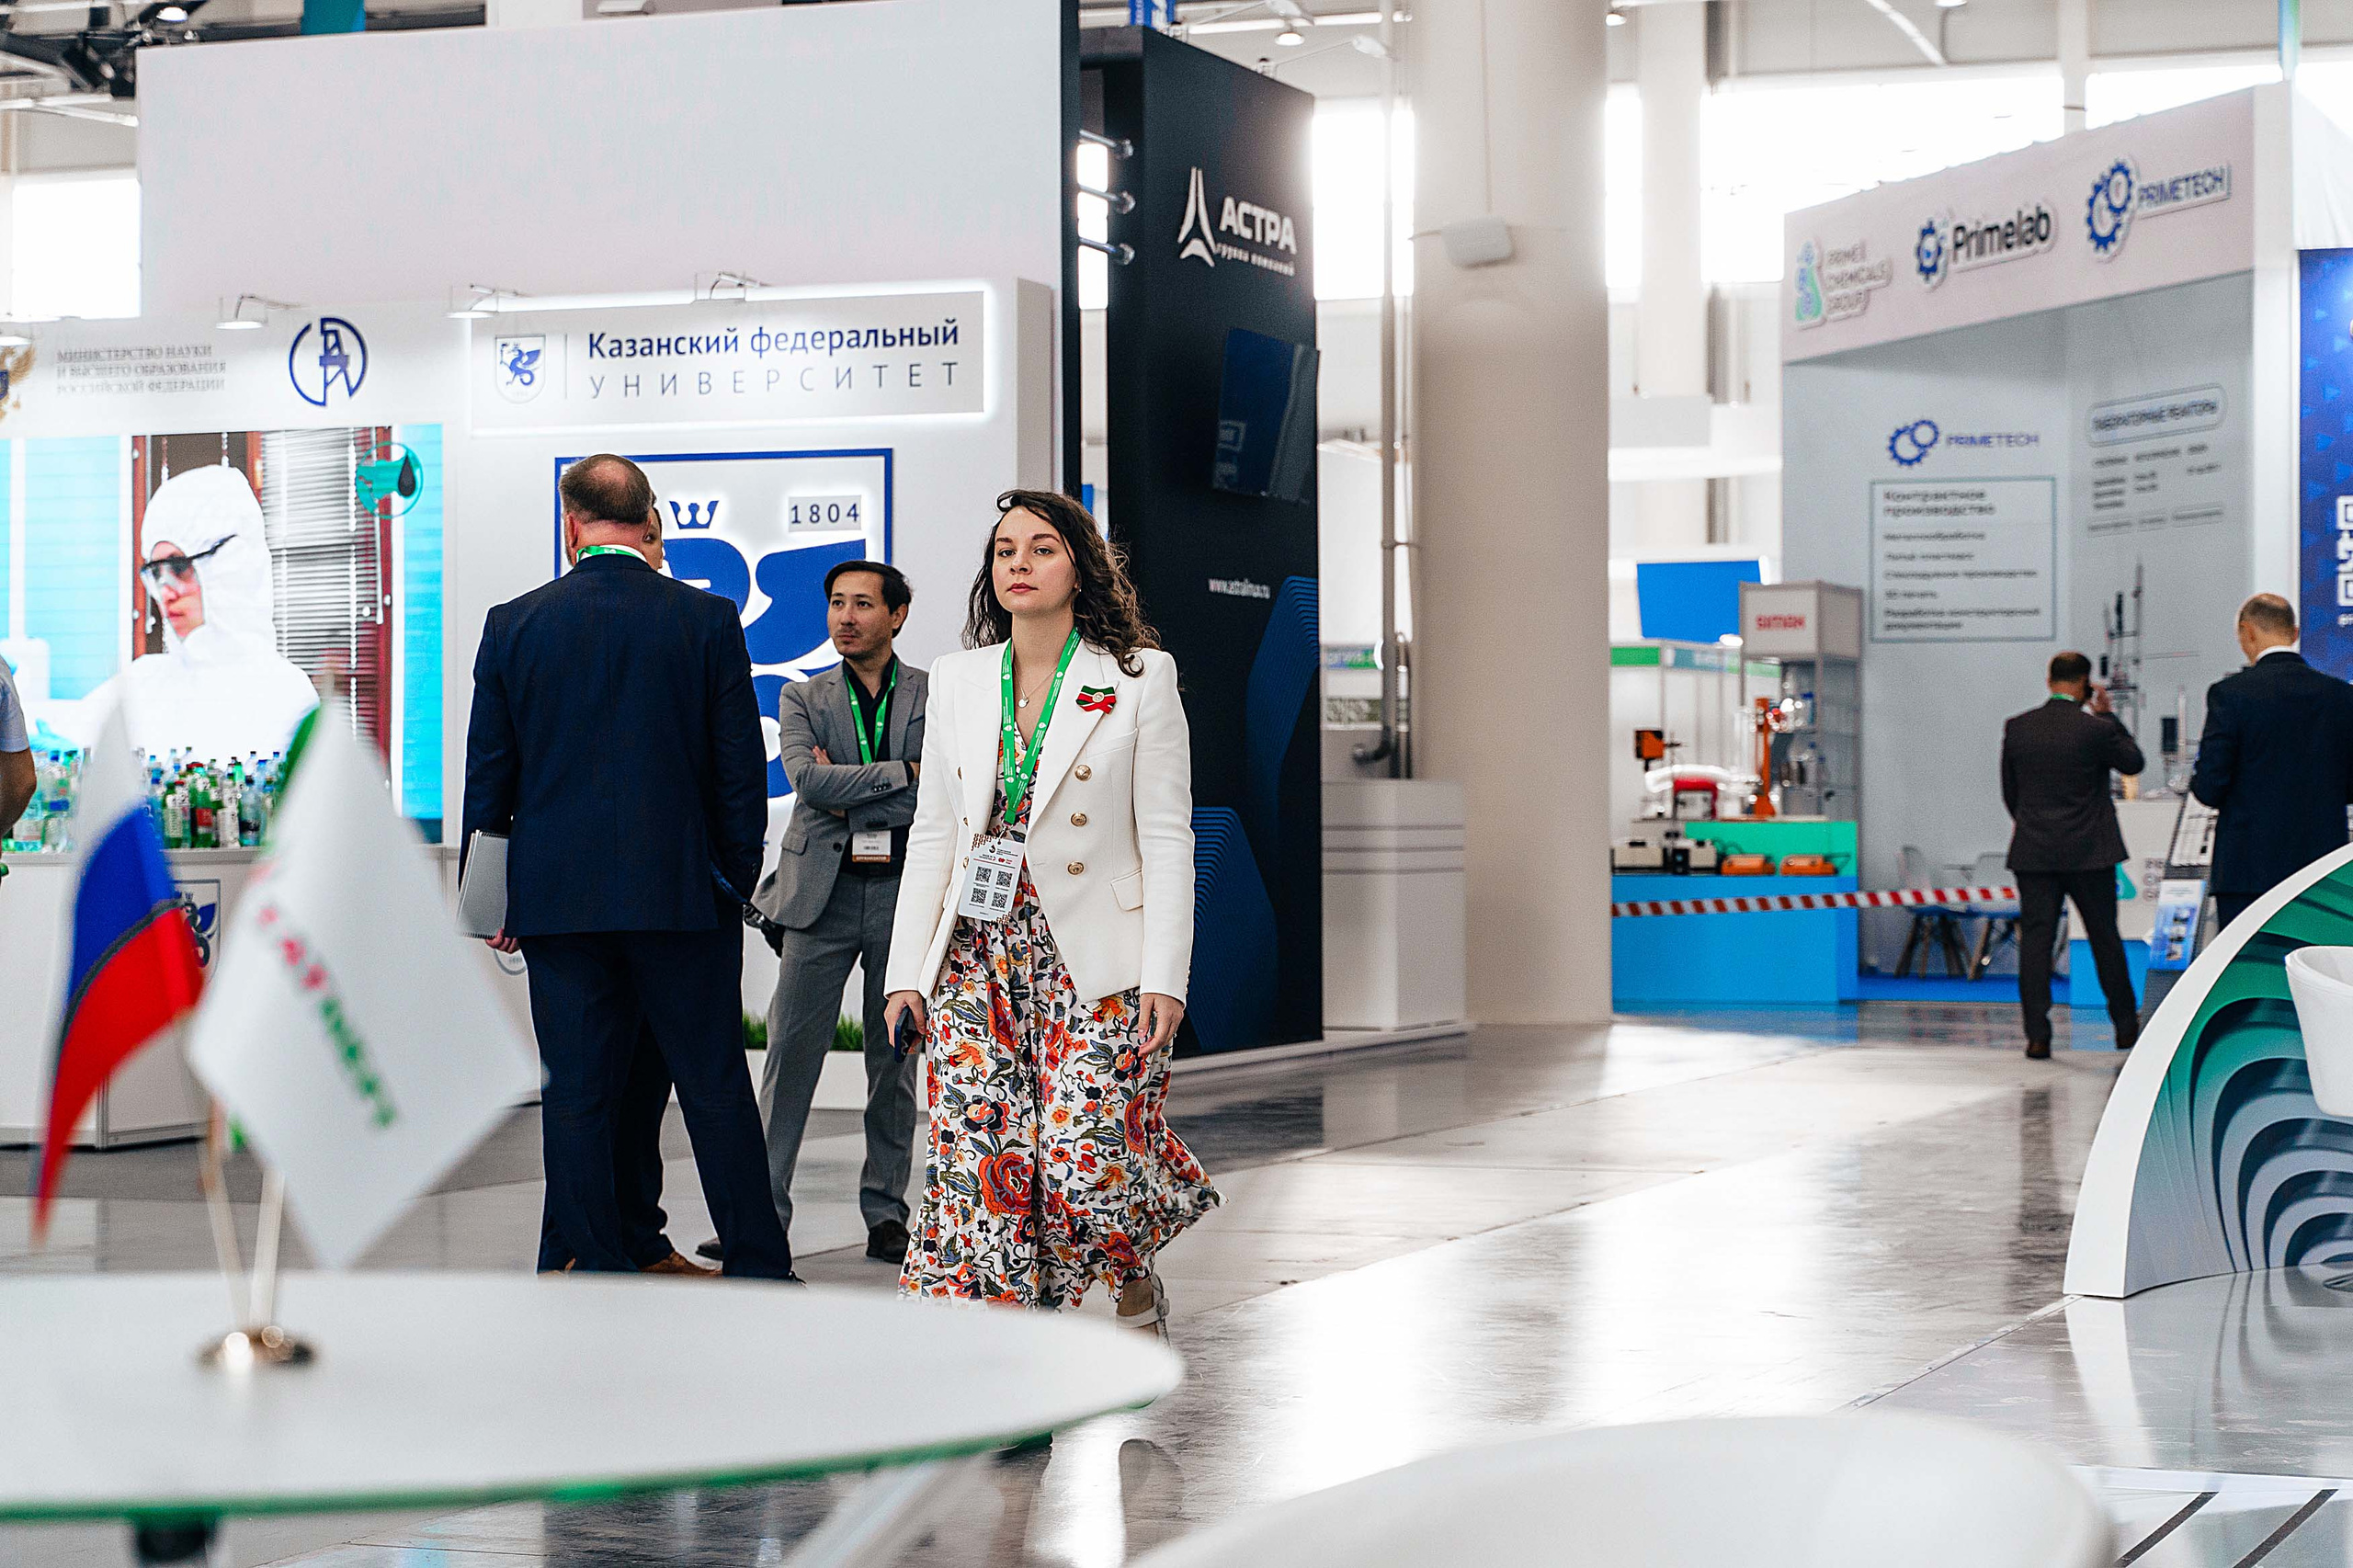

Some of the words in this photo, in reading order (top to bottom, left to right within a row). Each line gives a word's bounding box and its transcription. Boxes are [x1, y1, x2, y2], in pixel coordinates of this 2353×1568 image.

[2138, 167, 2224, 208] PRIMETECH
[1219, 196, 1297, 255] АСТРА
[1952, 205, 2052, 263] Primelab
[588, 327, 738, 360] Казанский
[750, 318, 961, 357] федеральный
[57, 347, 163, 364] МИНИСТЕРСТВО
[166, 345, 212, 359] НАУКИ
[135, 362, 226, 376] ОБРАЗОВАНИЯ
[148, 379, 225, 392] ФЕДЕРАЦИИ
[589, 362, 960, 399] УНИВЕРСИТЕТ
[1946, 434, 2040, 447] PRIMETECH
[790, 502, 861, 525] 1804
